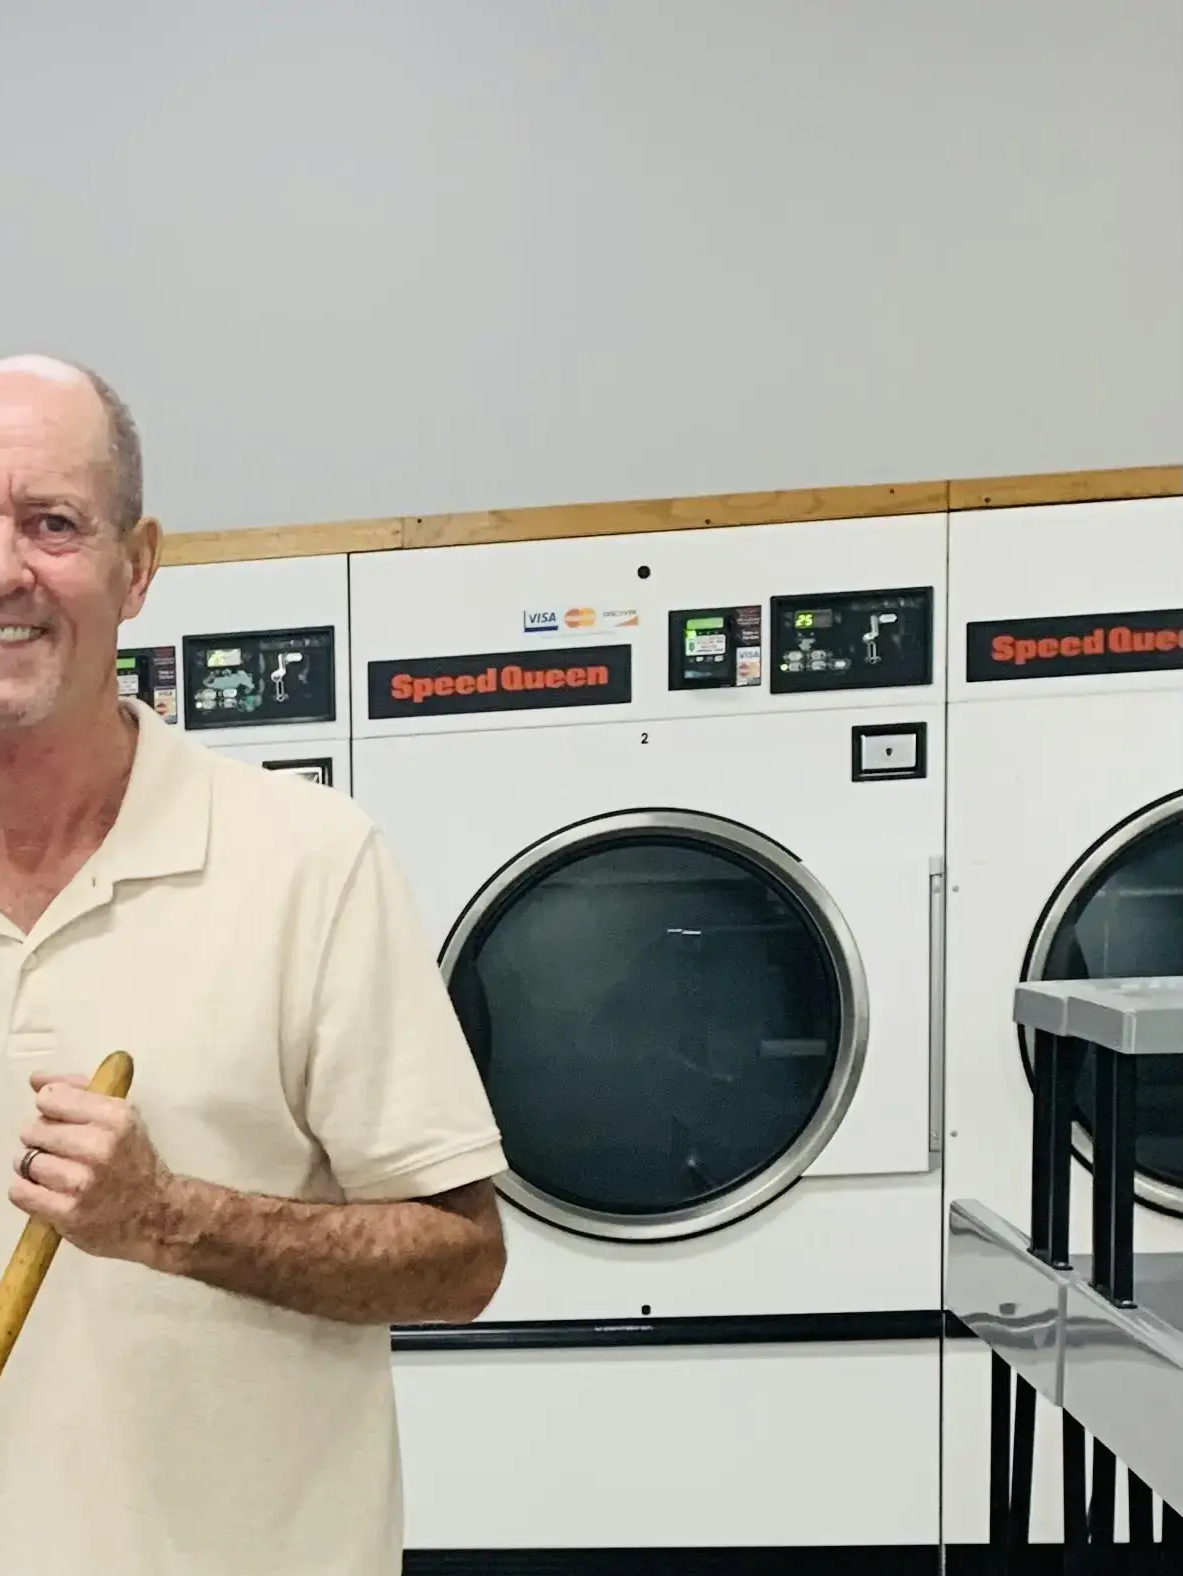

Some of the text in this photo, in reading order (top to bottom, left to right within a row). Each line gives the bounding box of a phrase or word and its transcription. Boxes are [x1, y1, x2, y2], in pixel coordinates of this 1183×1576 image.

[529, 612, 557, 624] VISA
[795, 613, 814, 627] 25
[990, 626, 1183, 665] Speed Que
[391, 664, 609, 704] Speed Queen
[640, 732, 650, 745] 2
